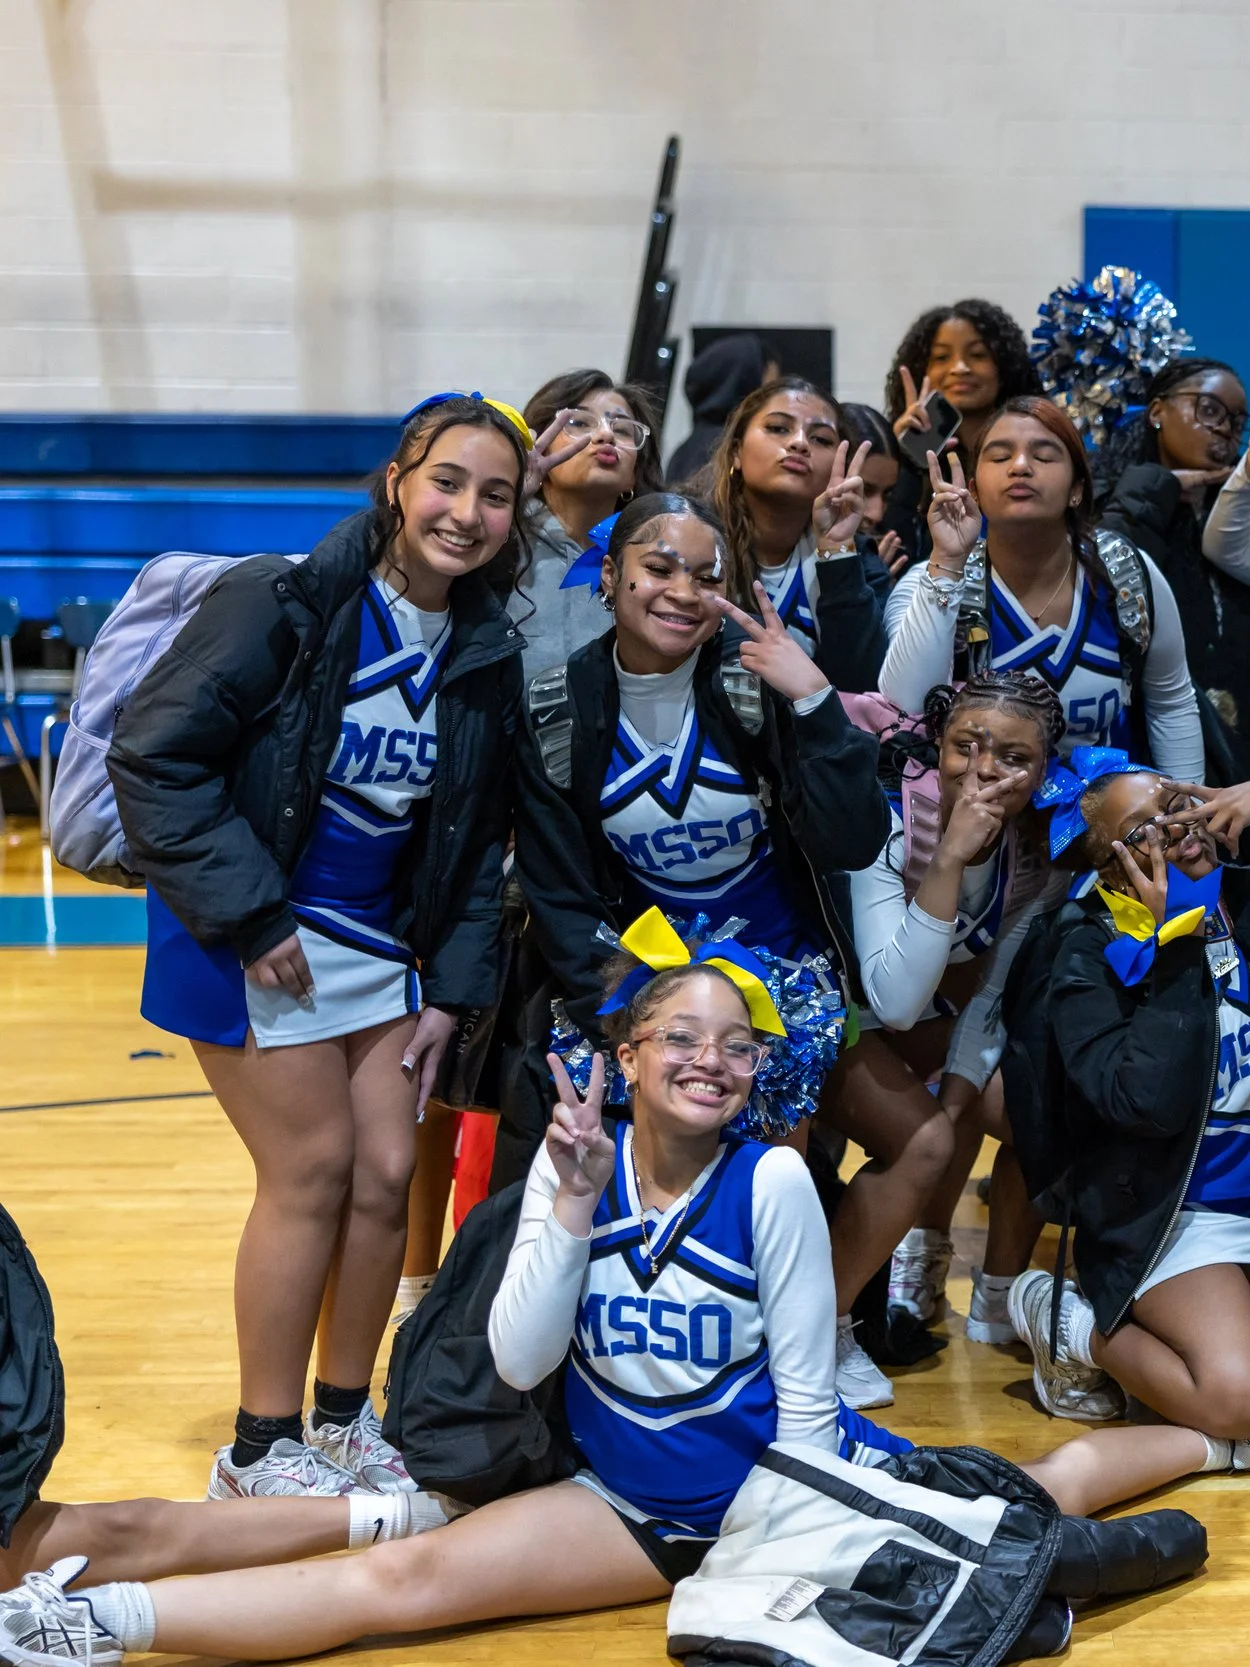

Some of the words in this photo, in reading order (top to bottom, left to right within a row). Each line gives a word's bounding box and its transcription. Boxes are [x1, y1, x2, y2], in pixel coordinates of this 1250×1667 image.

[1067, 688, 1119, 735] 50
[324, 721, 437, 787] MS5
[607, 808, 764, 872] MS50
[457, 1008, 481, 1054] RICAN
[576, 1293, 732, 1368] MS50
